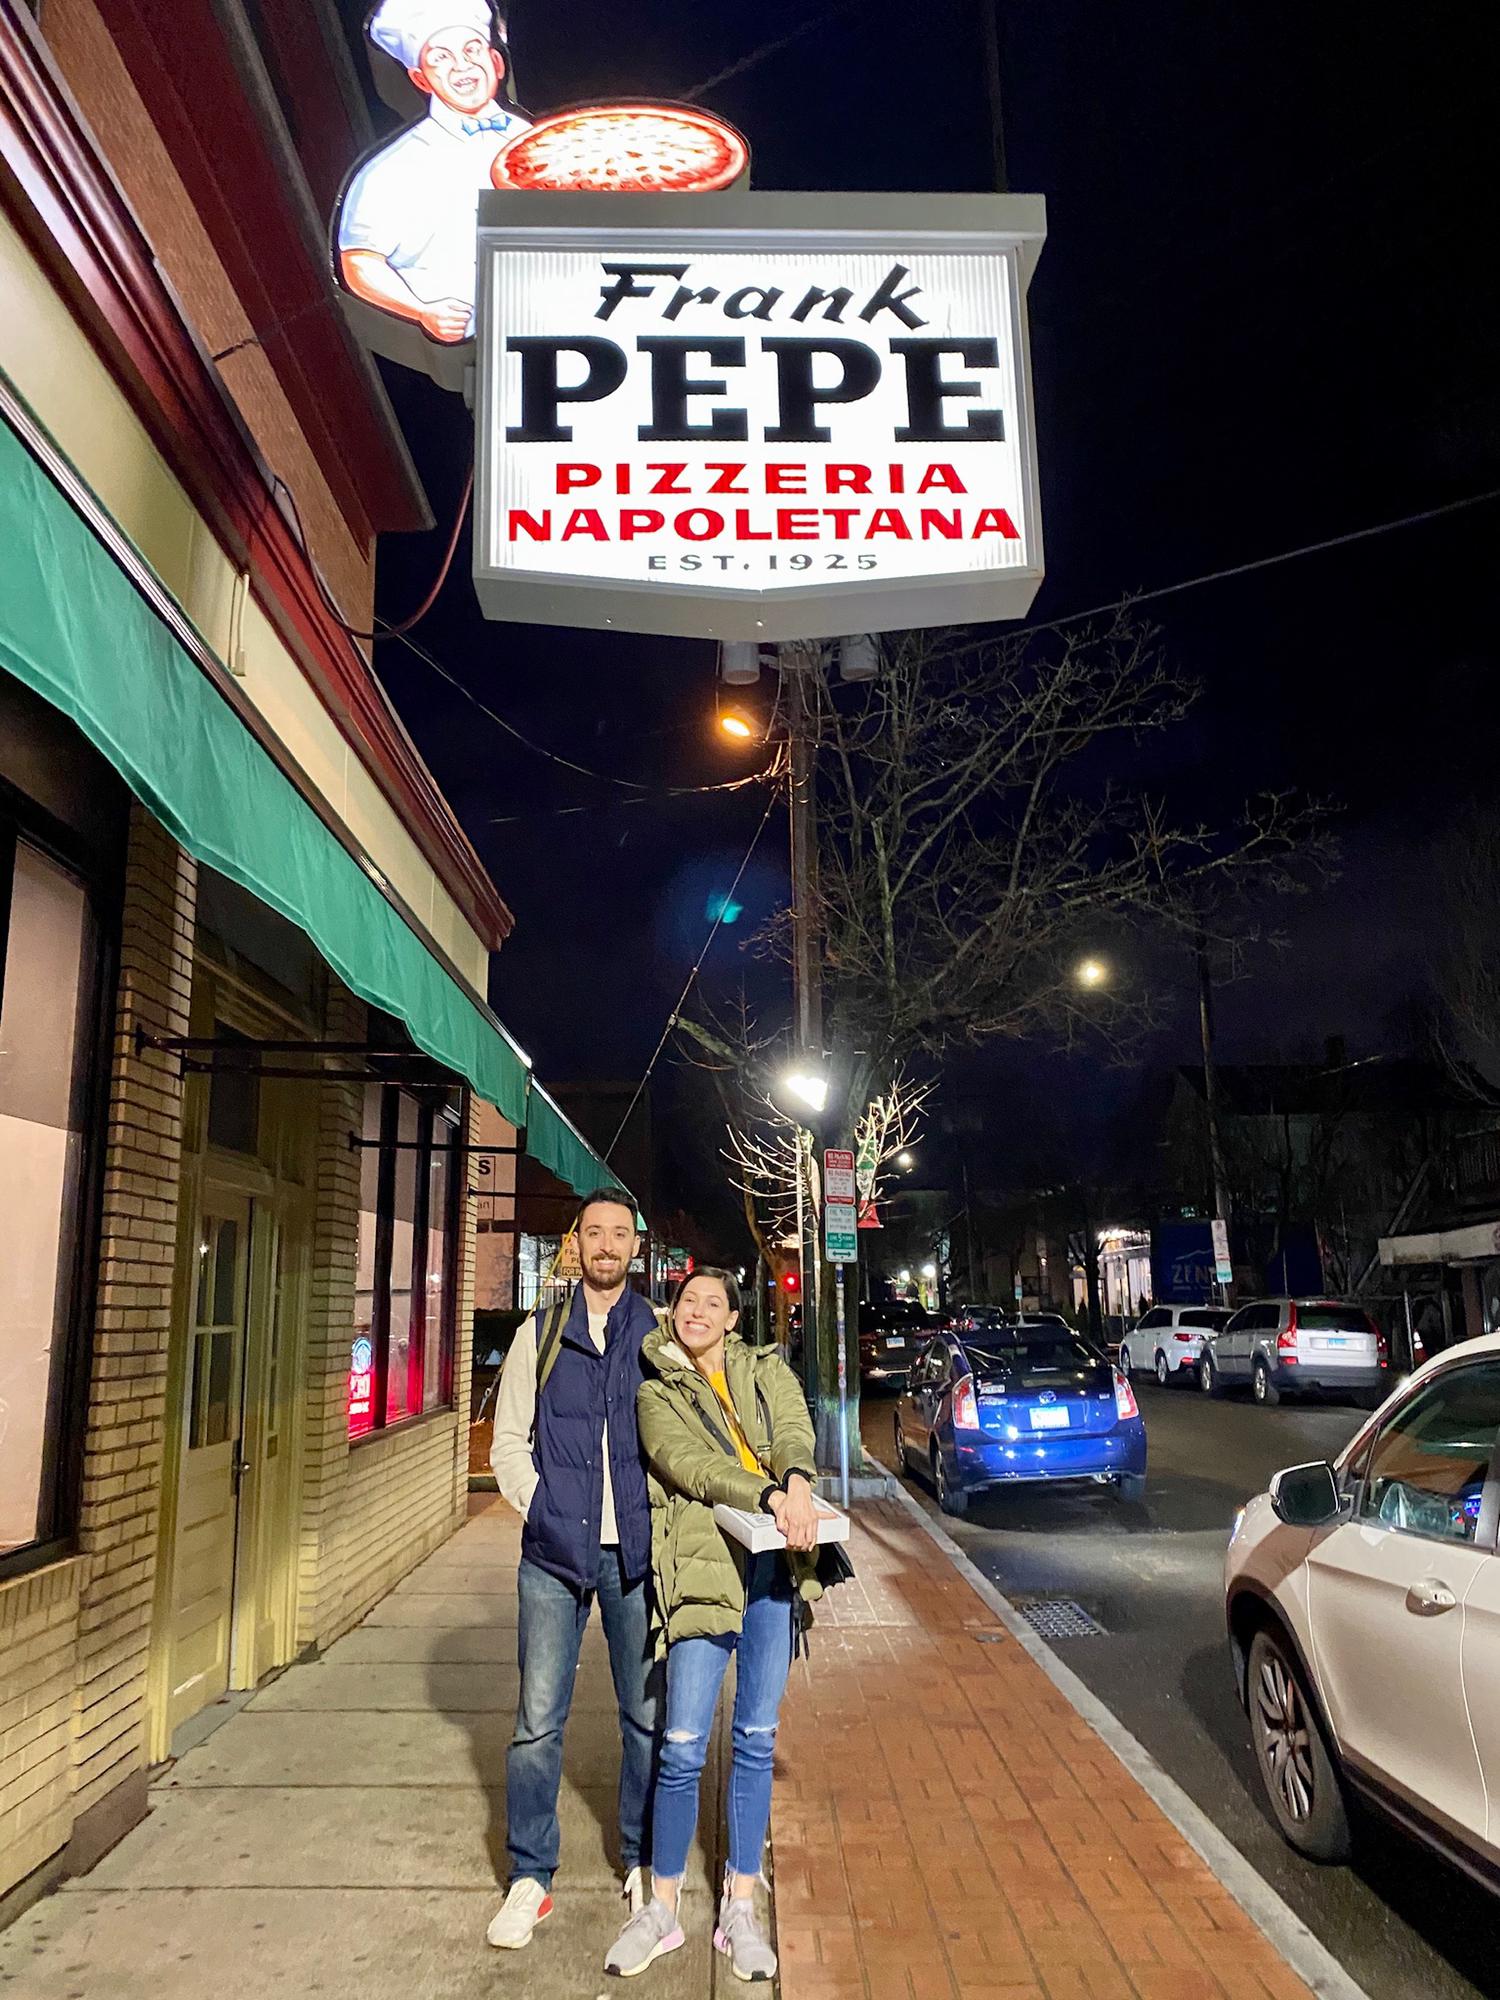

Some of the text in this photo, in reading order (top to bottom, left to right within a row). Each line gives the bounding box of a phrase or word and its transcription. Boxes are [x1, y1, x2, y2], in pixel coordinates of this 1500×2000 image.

[594, 262, 929, 330] Frank
[505, 335, 1006, 443] PEPE
[556, 463, 968, 494] PIZZERIA
[508, 508, 1020, 541] NAPOLETANA
[648, 554, 878, 570] EST. 1925
